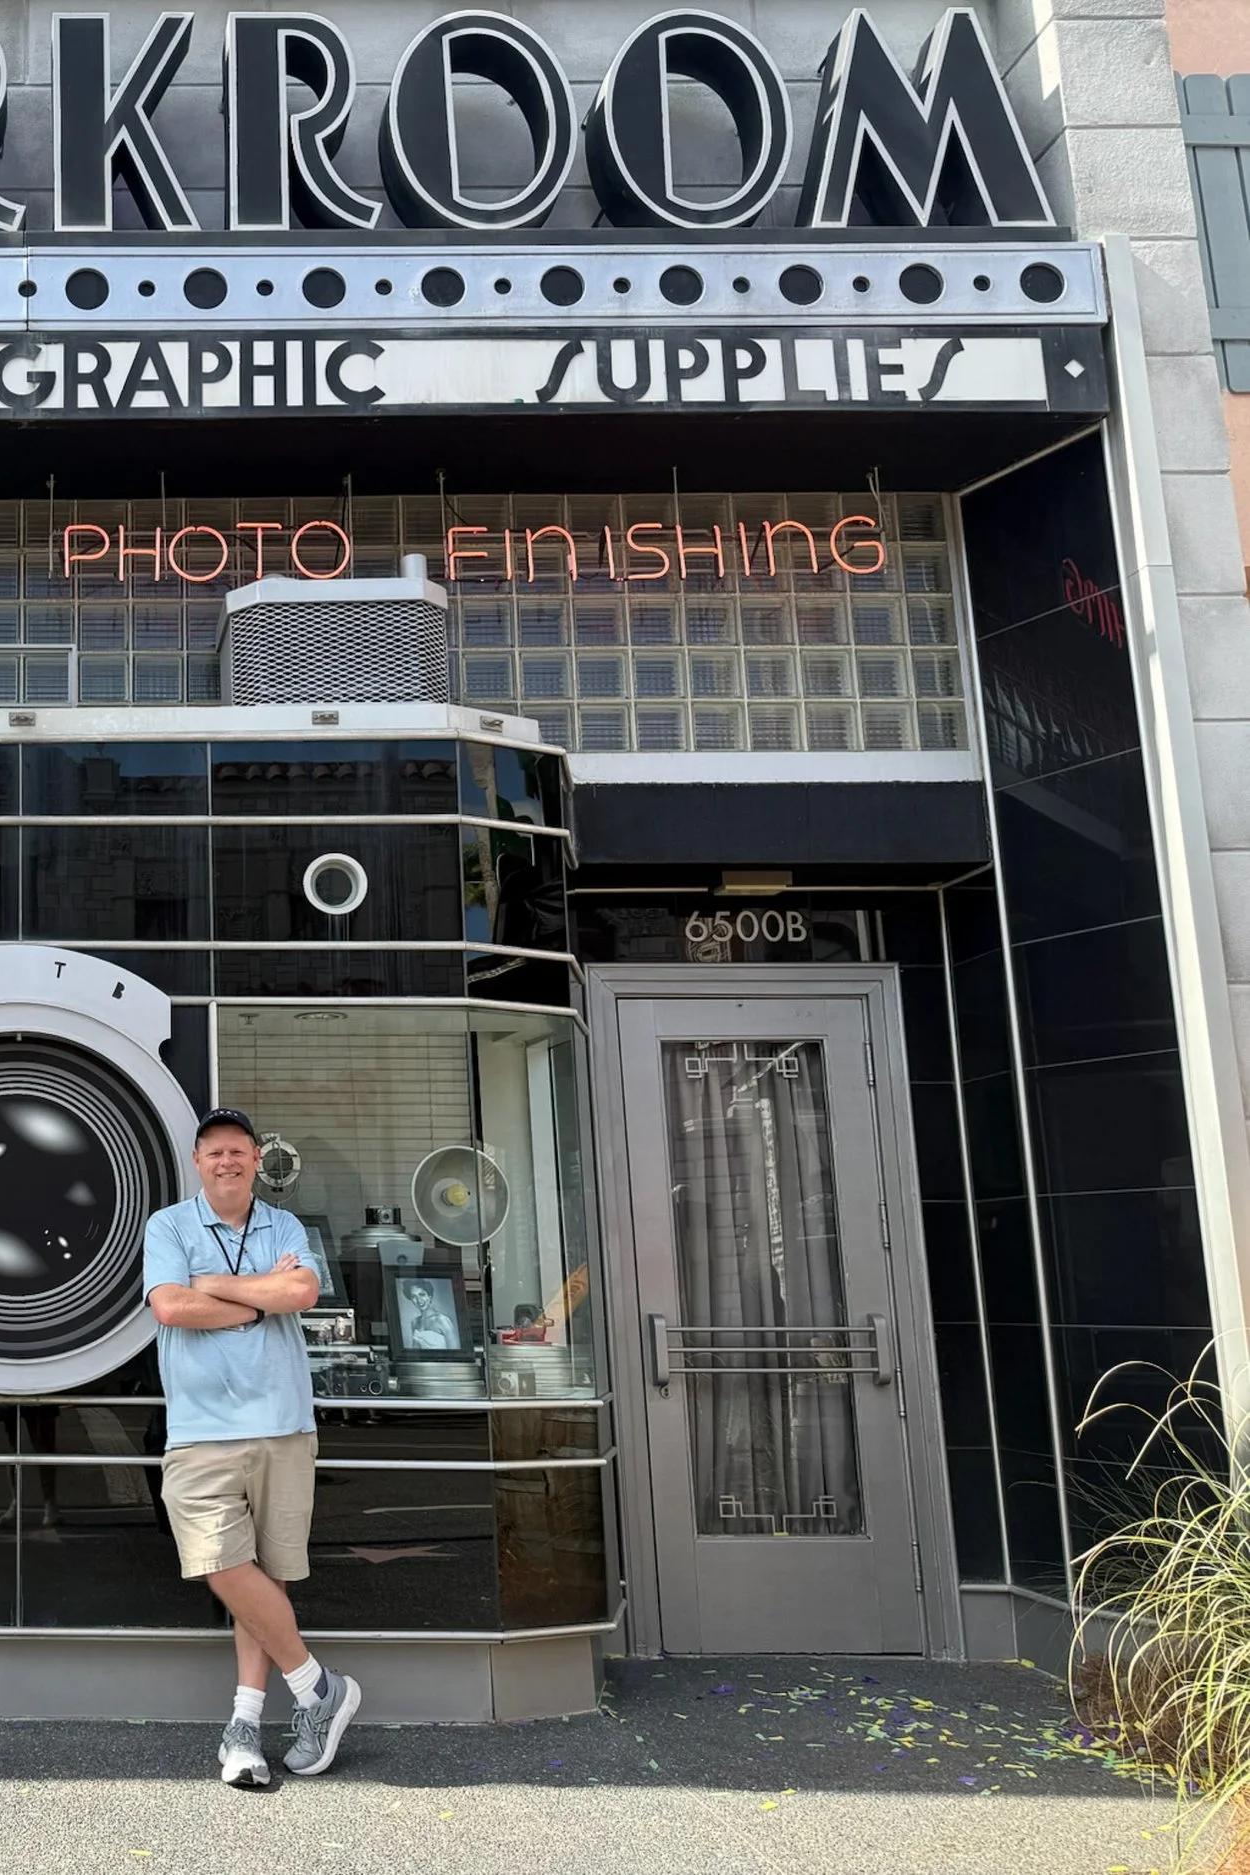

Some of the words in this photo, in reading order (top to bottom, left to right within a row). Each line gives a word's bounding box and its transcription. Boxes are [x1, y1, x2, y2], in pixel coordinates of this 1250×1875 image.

[535, 338, 964, 403] SUPPLIES
[62, 522, 352, 583] PHOTO
[447, 516, 887, 582] FINISHING
[685, 910, 807, 942] 6500B
[54, 961, 66, 978] T
[111, 981, 126, 1000] B
